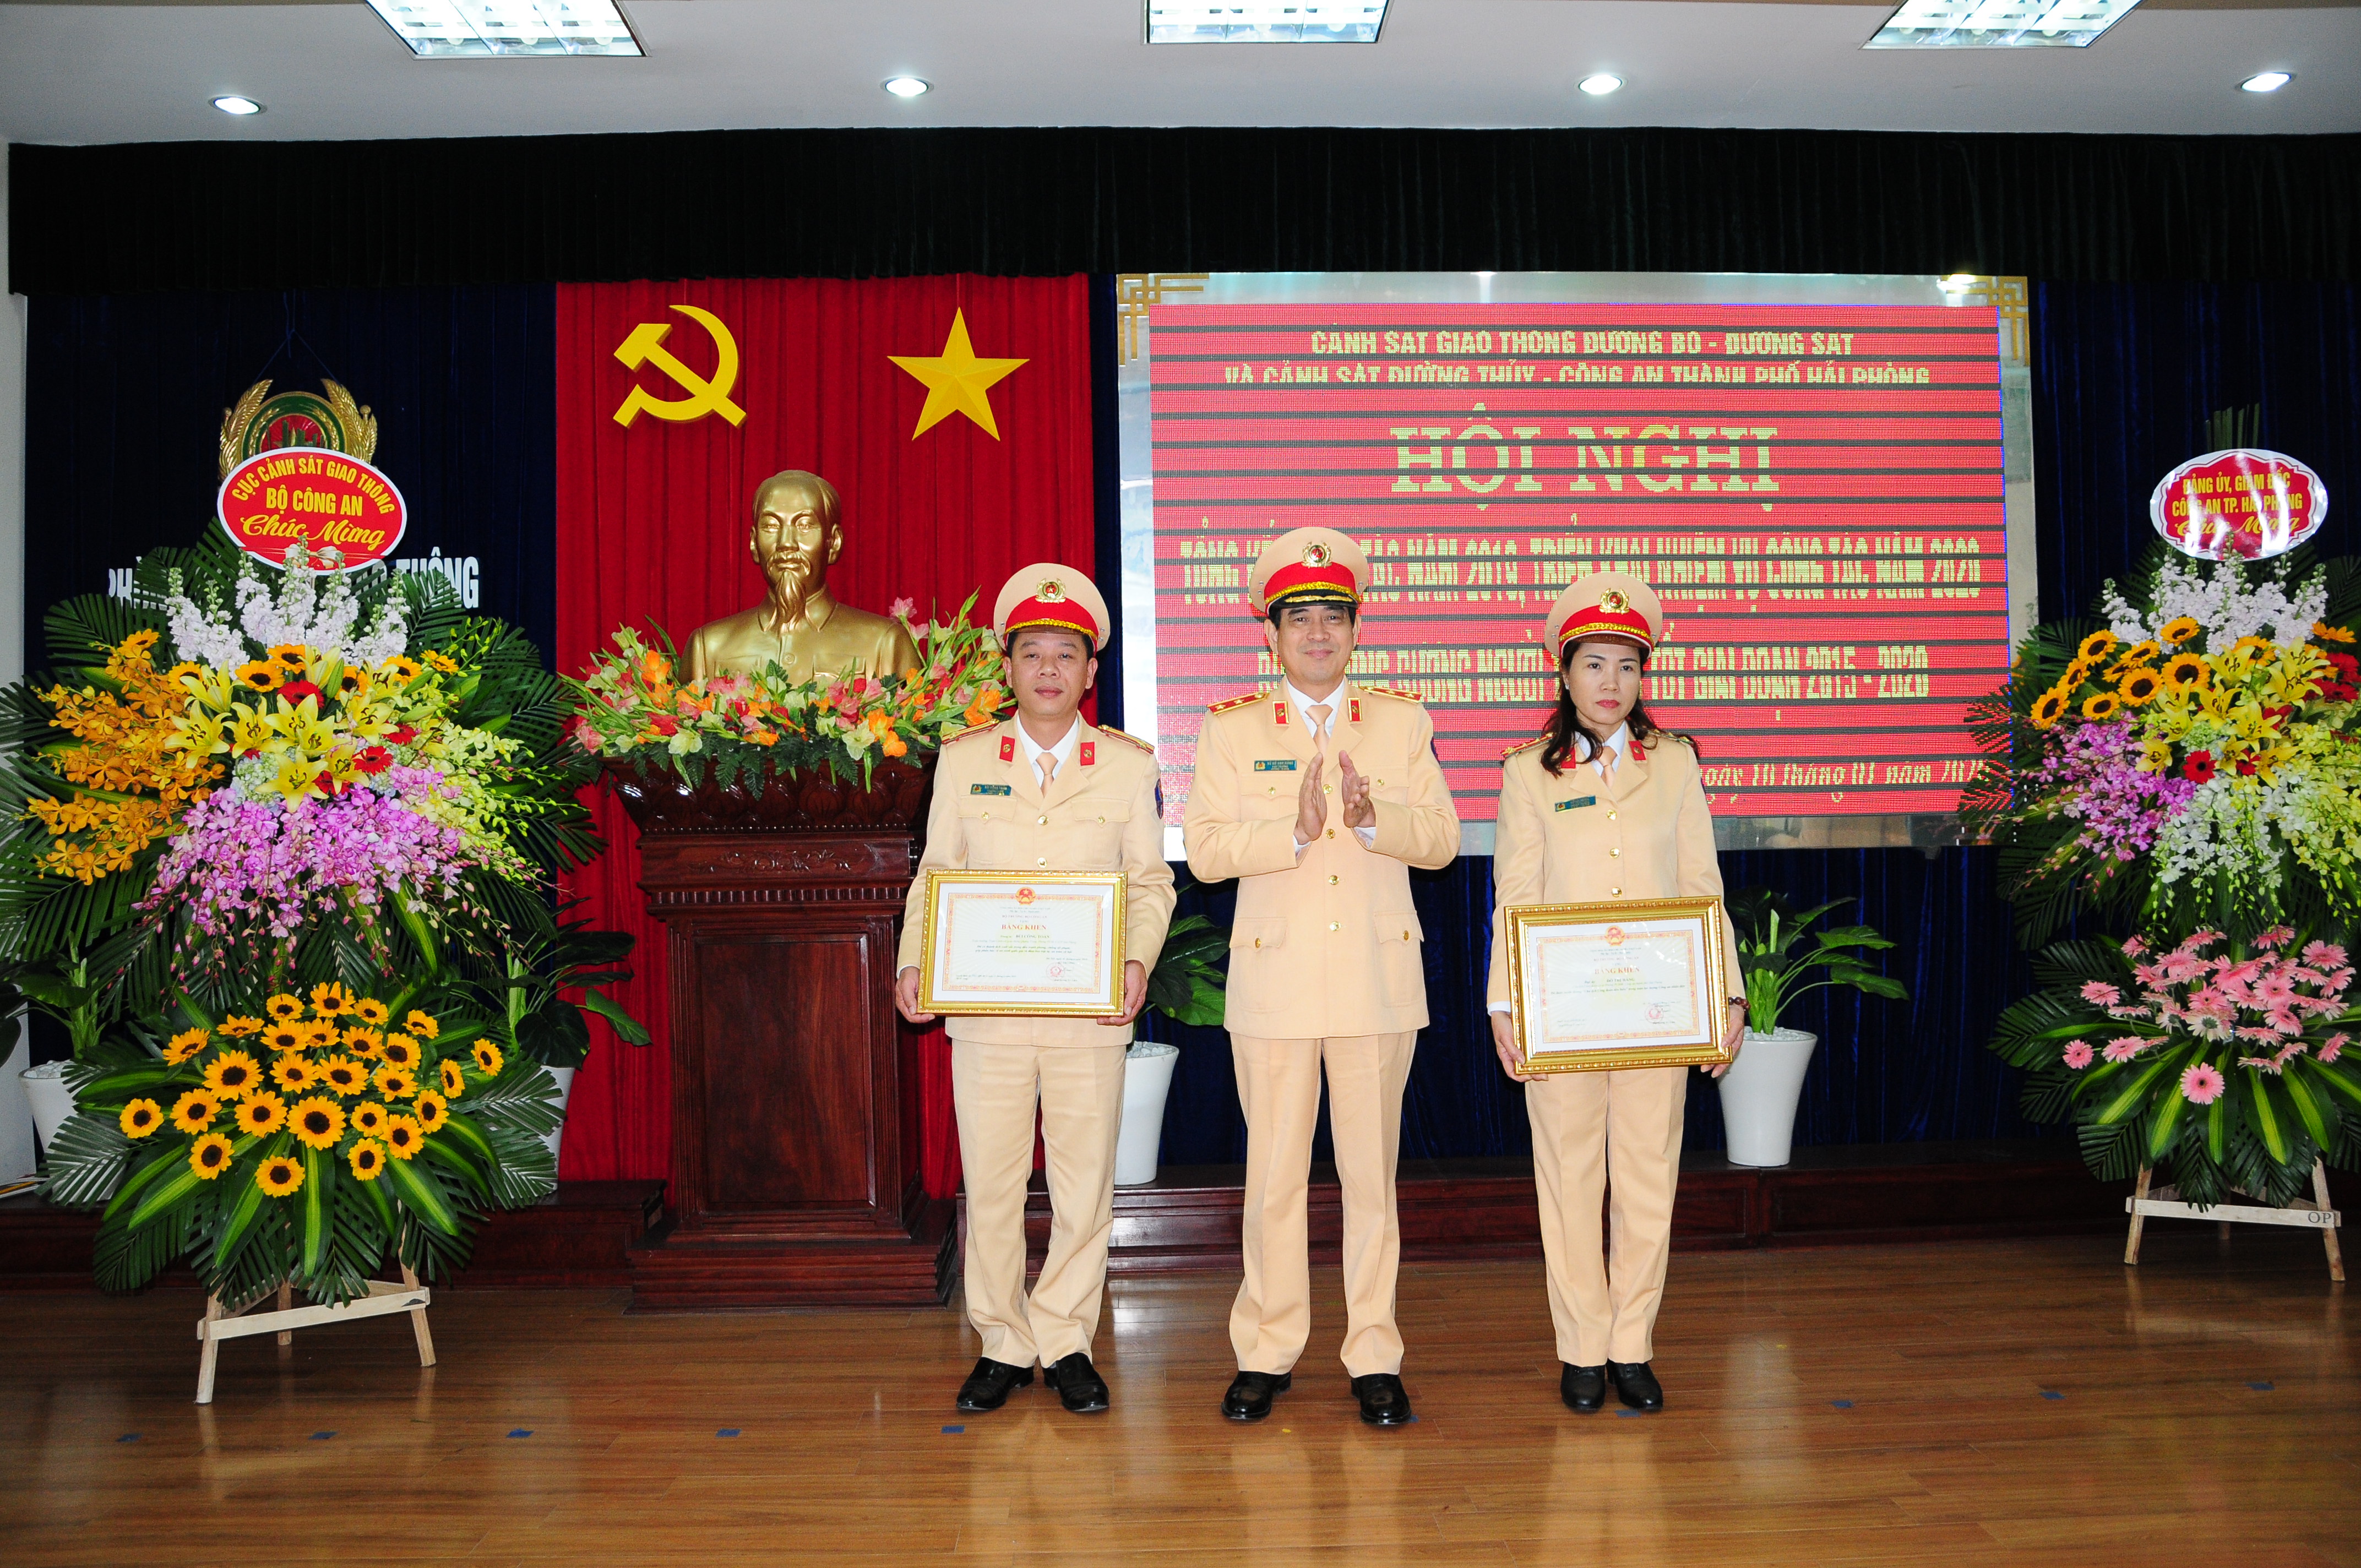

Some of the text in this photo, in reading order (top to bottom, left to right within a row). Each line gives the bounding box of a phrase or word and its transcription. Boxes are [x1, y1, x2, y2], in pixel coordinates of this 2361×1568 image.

[1437, 330, 1492, 353] GIAO
[1390, 402, 1780, 511] HỘI NGHỊ
[232, 454, 395, 515] CỤC CẢNH SÁT GIAO THÔNG
[2216, 471, 2232, 494] ỦY,
[266, 484, 363, 516] BỘ CÔNG AN
[2206, 498, 2222, 515] AN
[2223, 497, 2239, 514] TP.
[2264, 493, 2303, 511] PHNG
[240, 514, 385, 551] Chúc Mừng
[2308, 1212, 2331, 1223] OP
